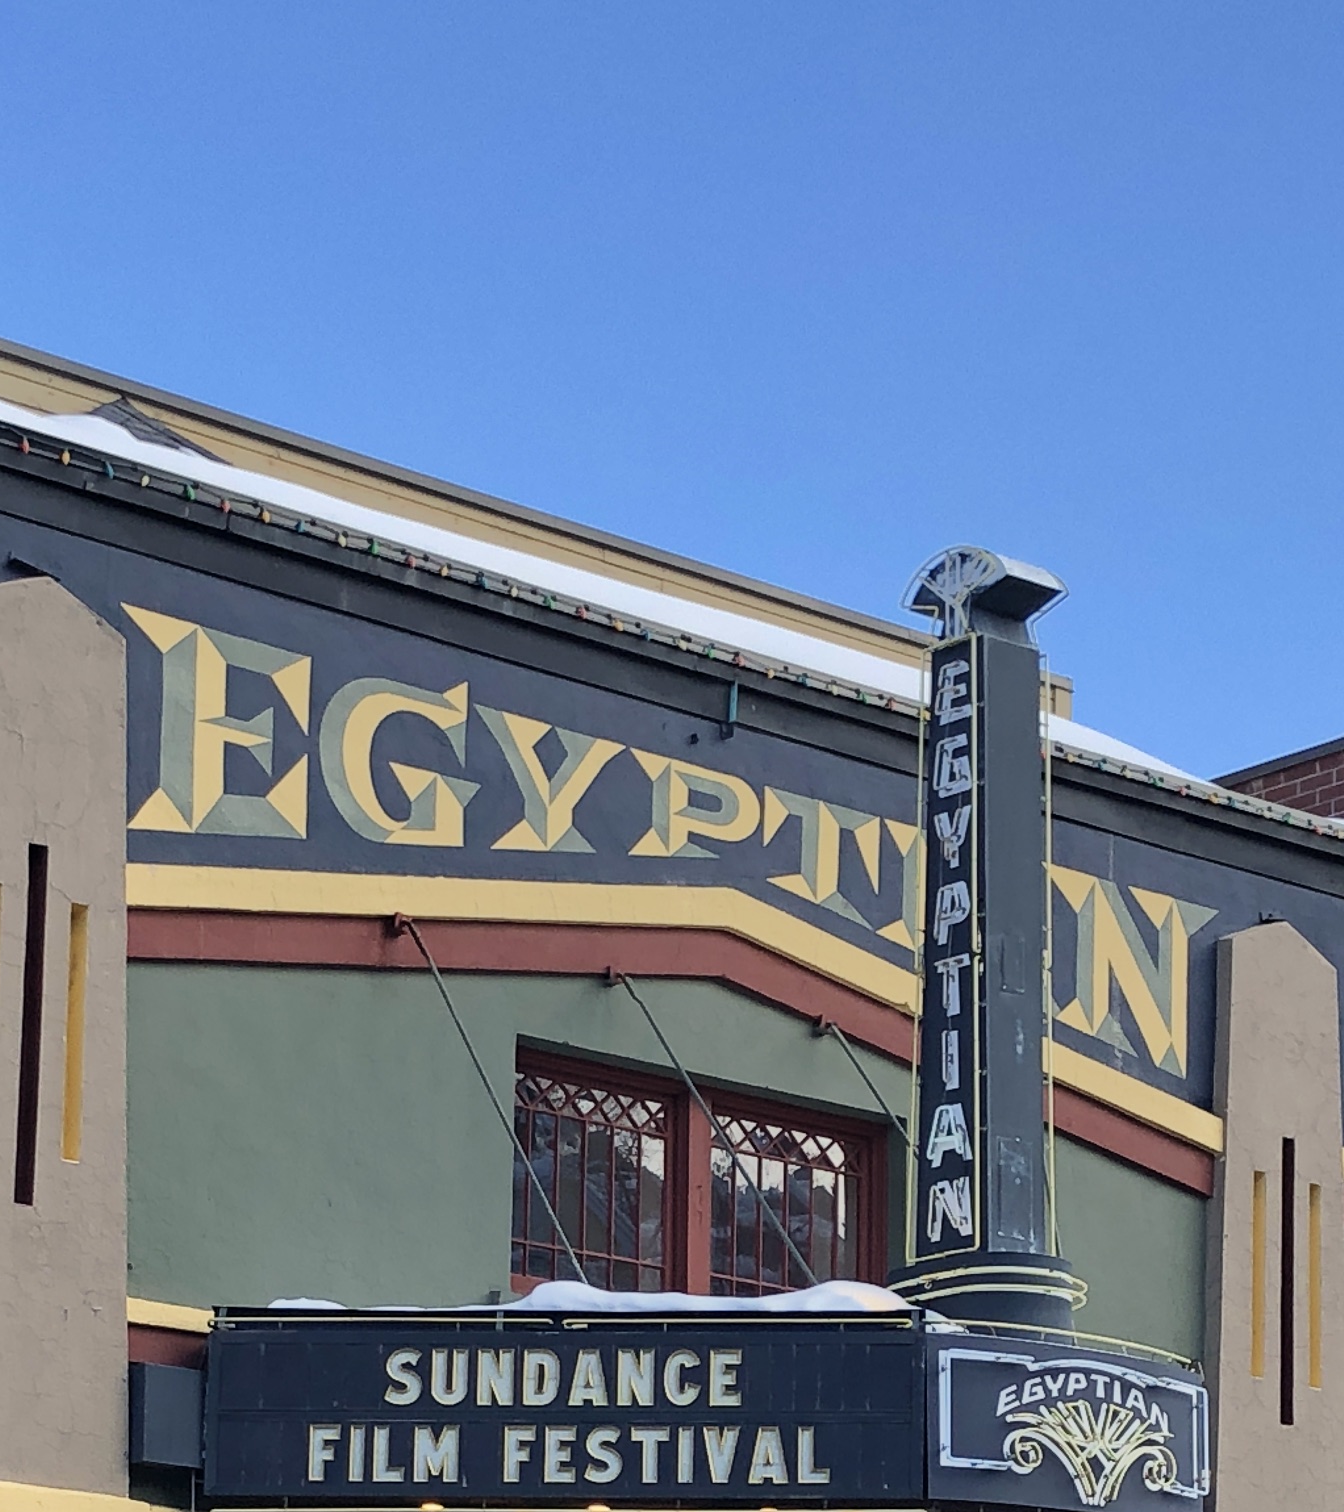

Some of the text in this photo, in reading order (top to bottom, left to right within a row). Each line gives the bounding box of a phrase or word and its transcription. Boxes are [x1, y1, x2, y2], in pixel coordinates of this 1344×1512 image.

[120, 602, 1219, 1080] EGYPTIN
[926, 658, 974, 1244] EGYPTIAN
[384, 1346, 744, 1408] SUNDANCE
[995, 1372, 1170, 1438] EGYPTIAN
[308, 1424, 831, 1486] FILM FESTIVAL
